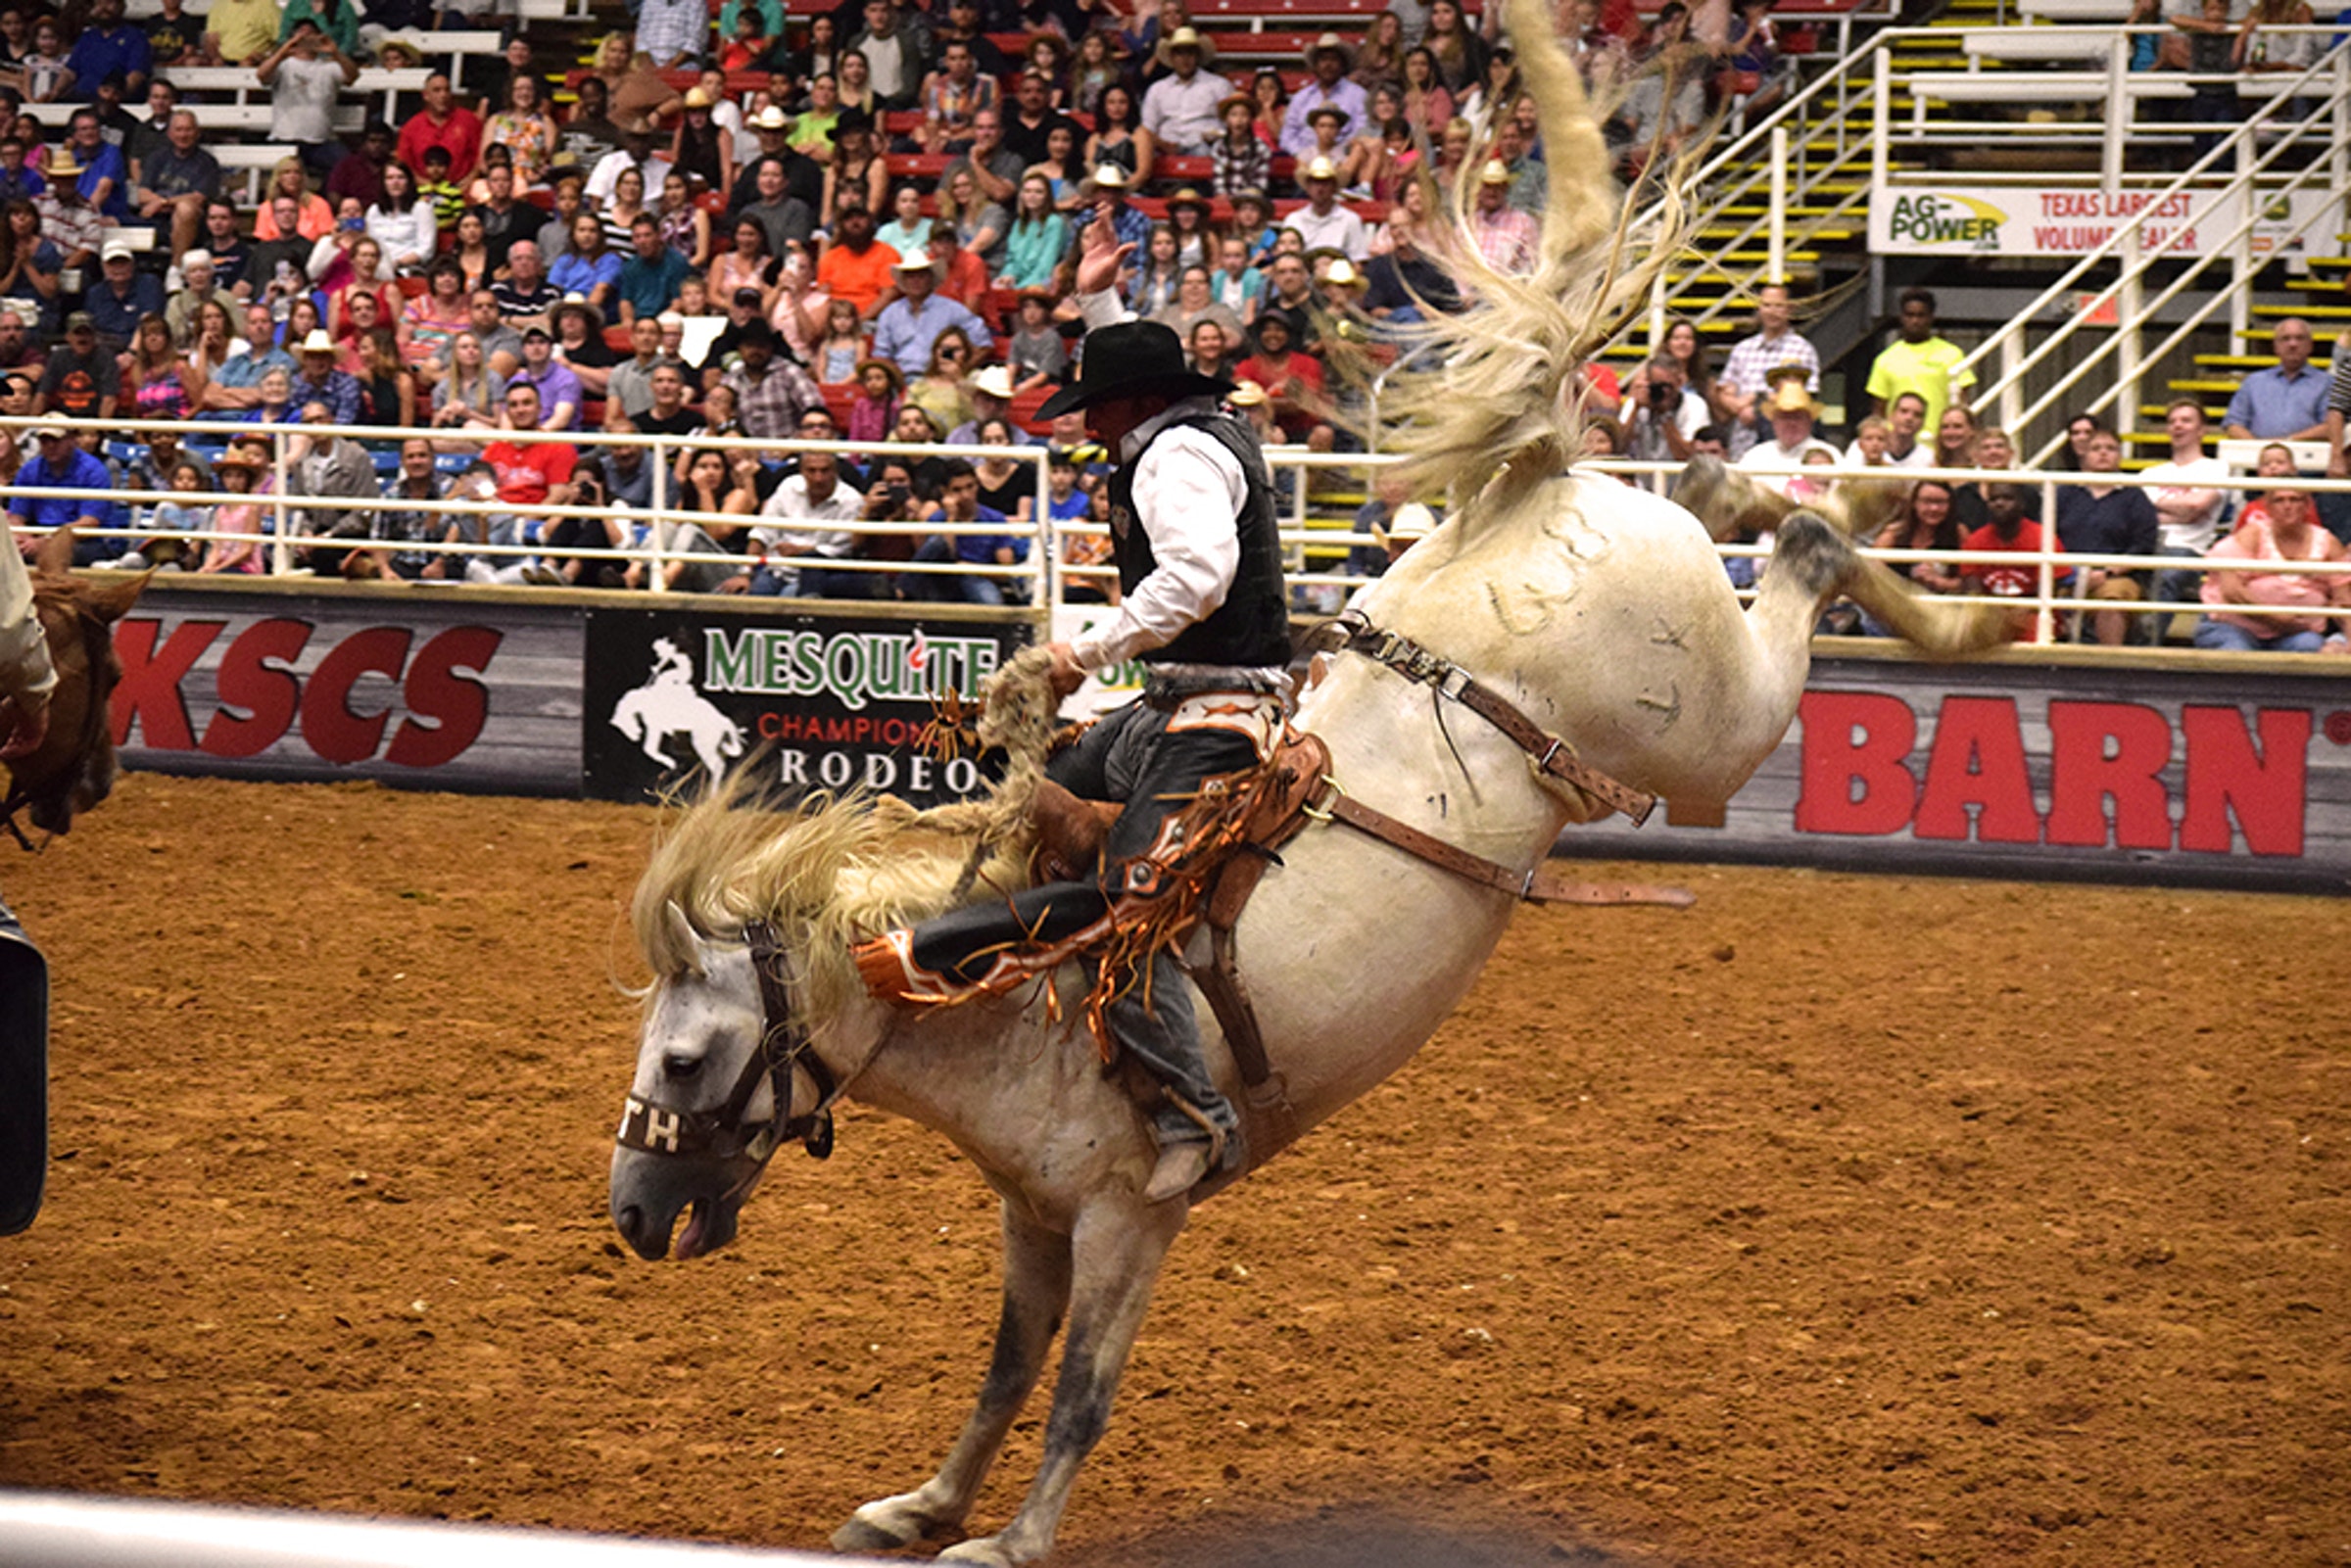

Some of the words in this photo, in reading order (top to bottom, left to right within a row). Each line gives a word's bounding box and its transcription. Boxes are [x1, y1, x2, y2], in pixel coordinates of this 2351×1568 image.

[1892, 195, 1952, 218] AG-
[2040, 194, 2100, 217] TEXAS
[1890, 217, 1997, 241] POWER
[2138, 226, 2197, 251] EALER
[106, 618, 504, 768] KSCS
[757, 712, 942, 748] CHAMPION
[781, 749, 979, 793] RODEO
[1794, 689, 2313, 857] BARN
